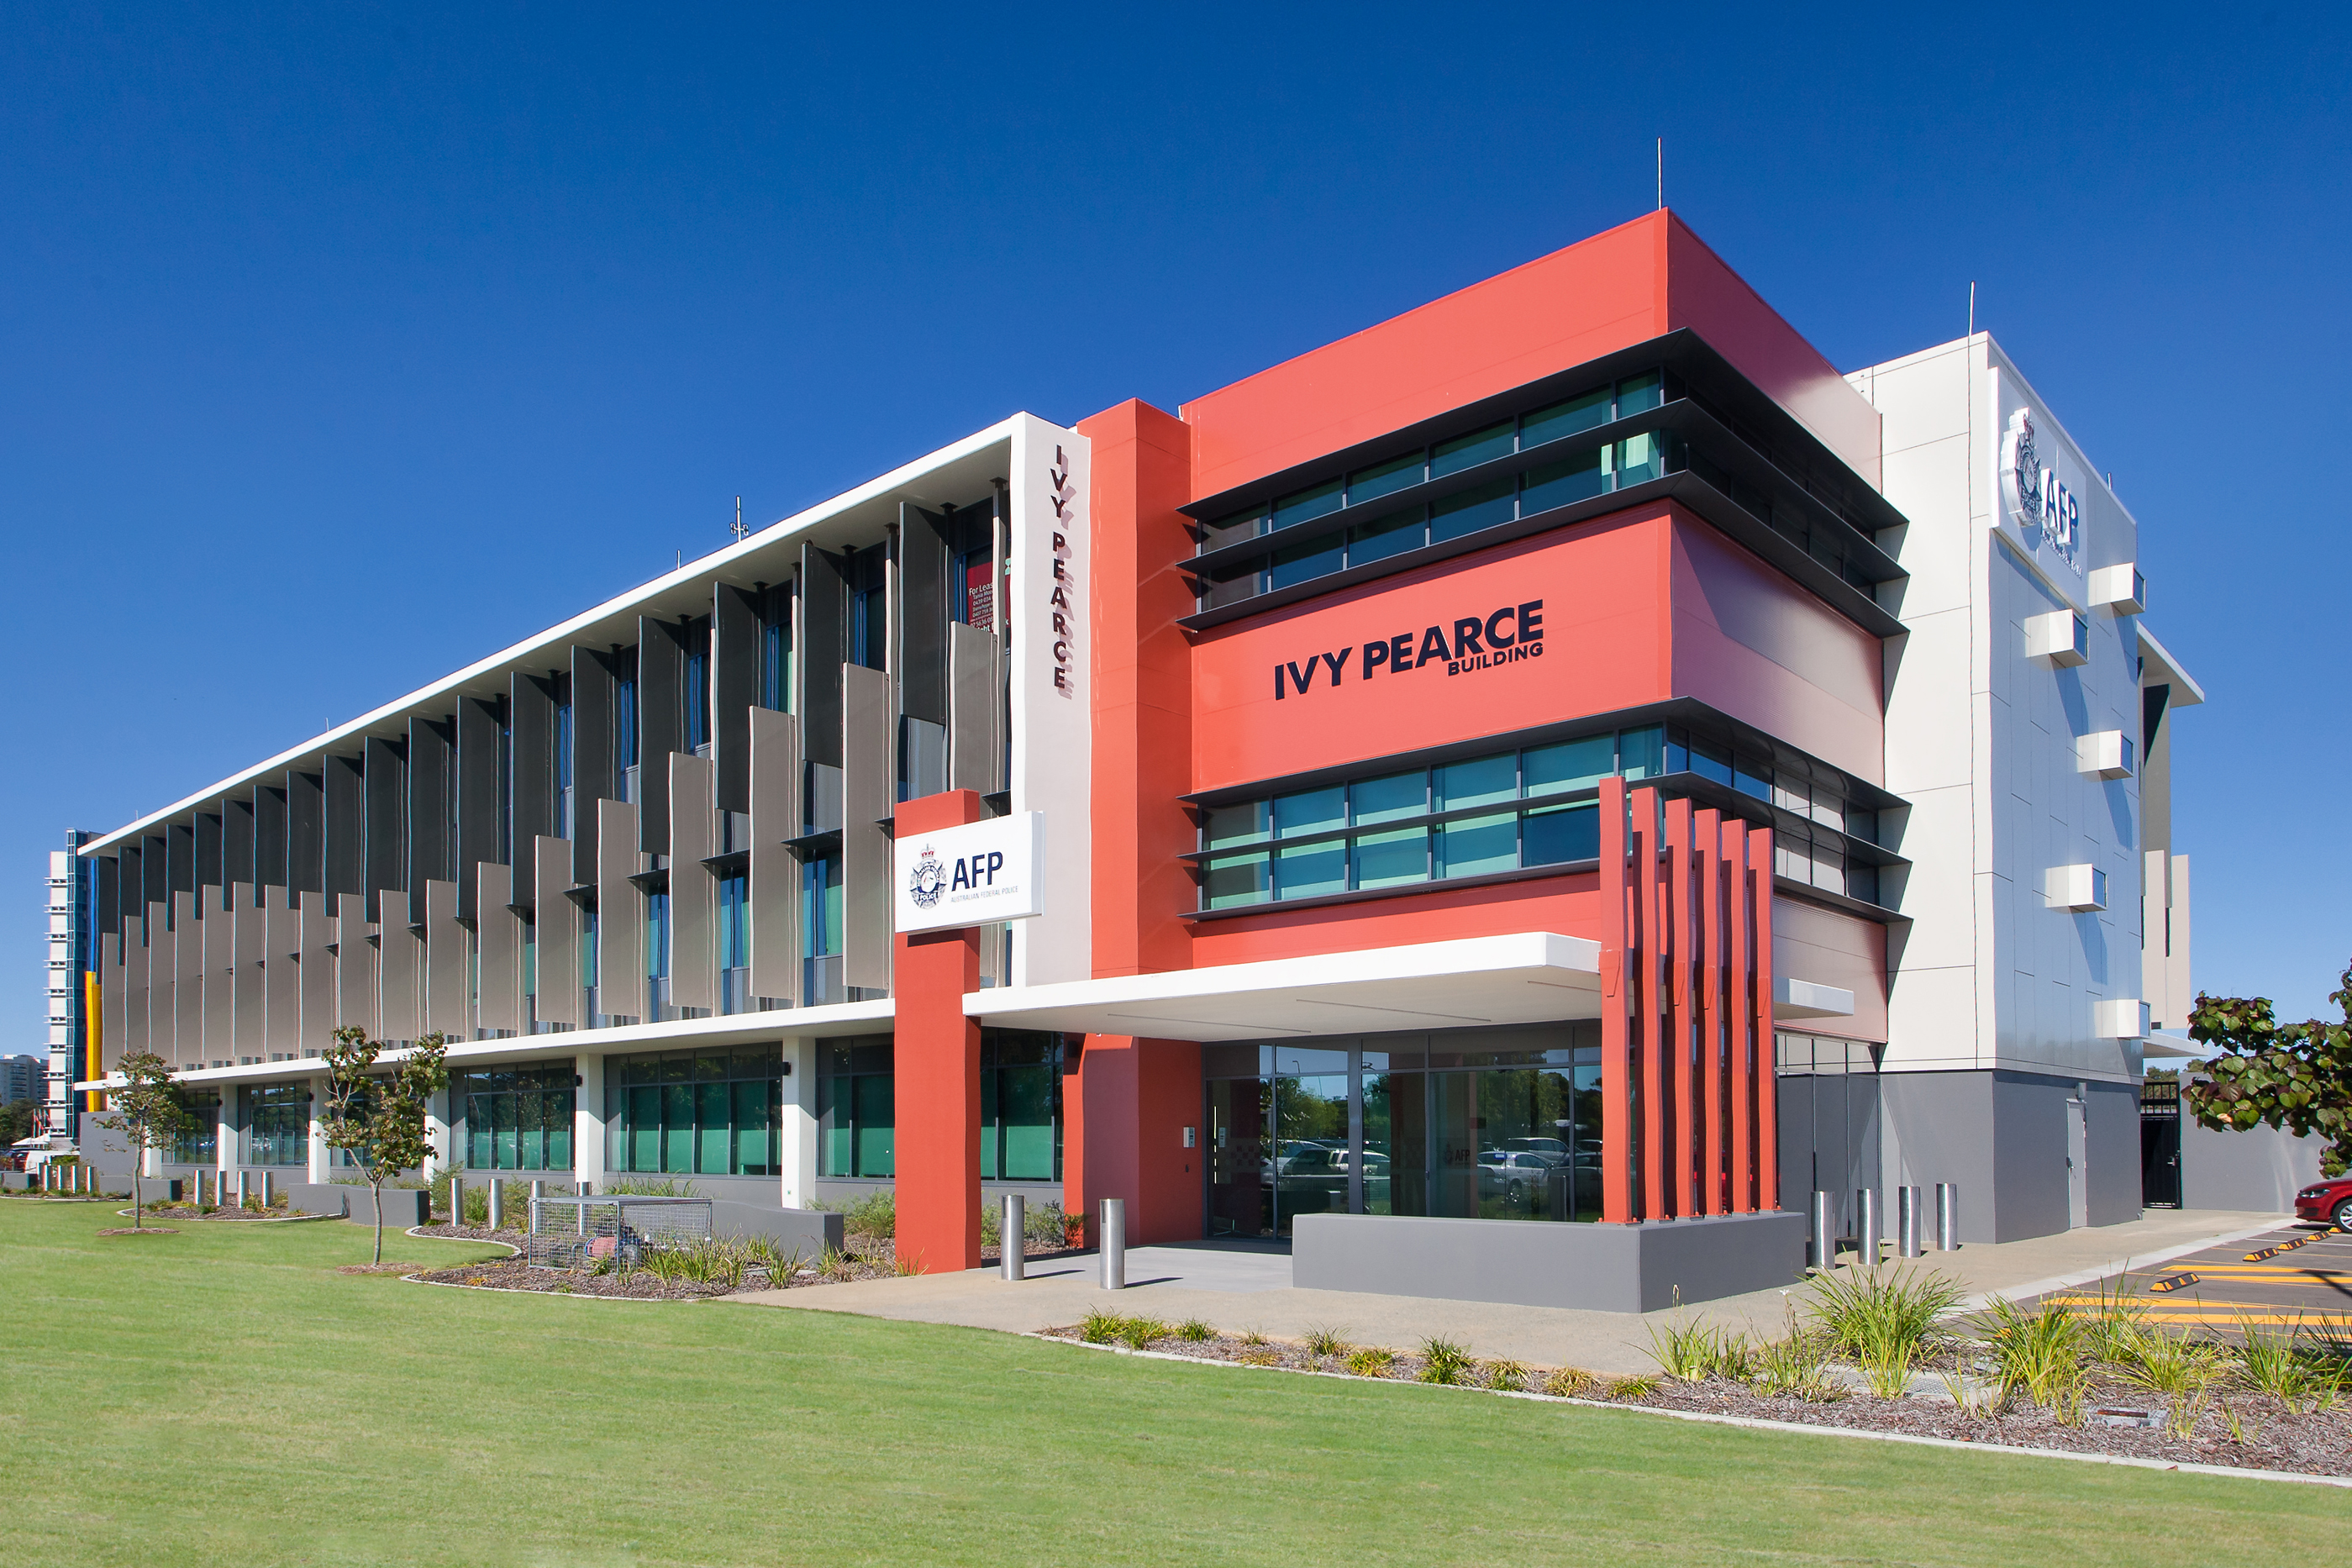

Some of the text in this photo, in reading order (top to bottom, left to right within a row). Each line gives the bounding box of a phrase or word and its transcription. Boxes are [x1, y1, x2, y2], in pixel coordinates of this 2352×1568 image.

[2041, 468, 2079, 545] AFP
[1050, 445, 1068, 689] IVY PEARCE
[969, 582, 992, 596] For Leas
[1275, 599, 1544, 701] IVY PEARCE
[1448, 642, 1544, 676] BUILDING
[951, 851, 1003, 892] AFP
[951, 886, 1018, 902] AUSTRALIAN FEDERAL POLICE
[1455, 1150, 1470, 1160] AFP
